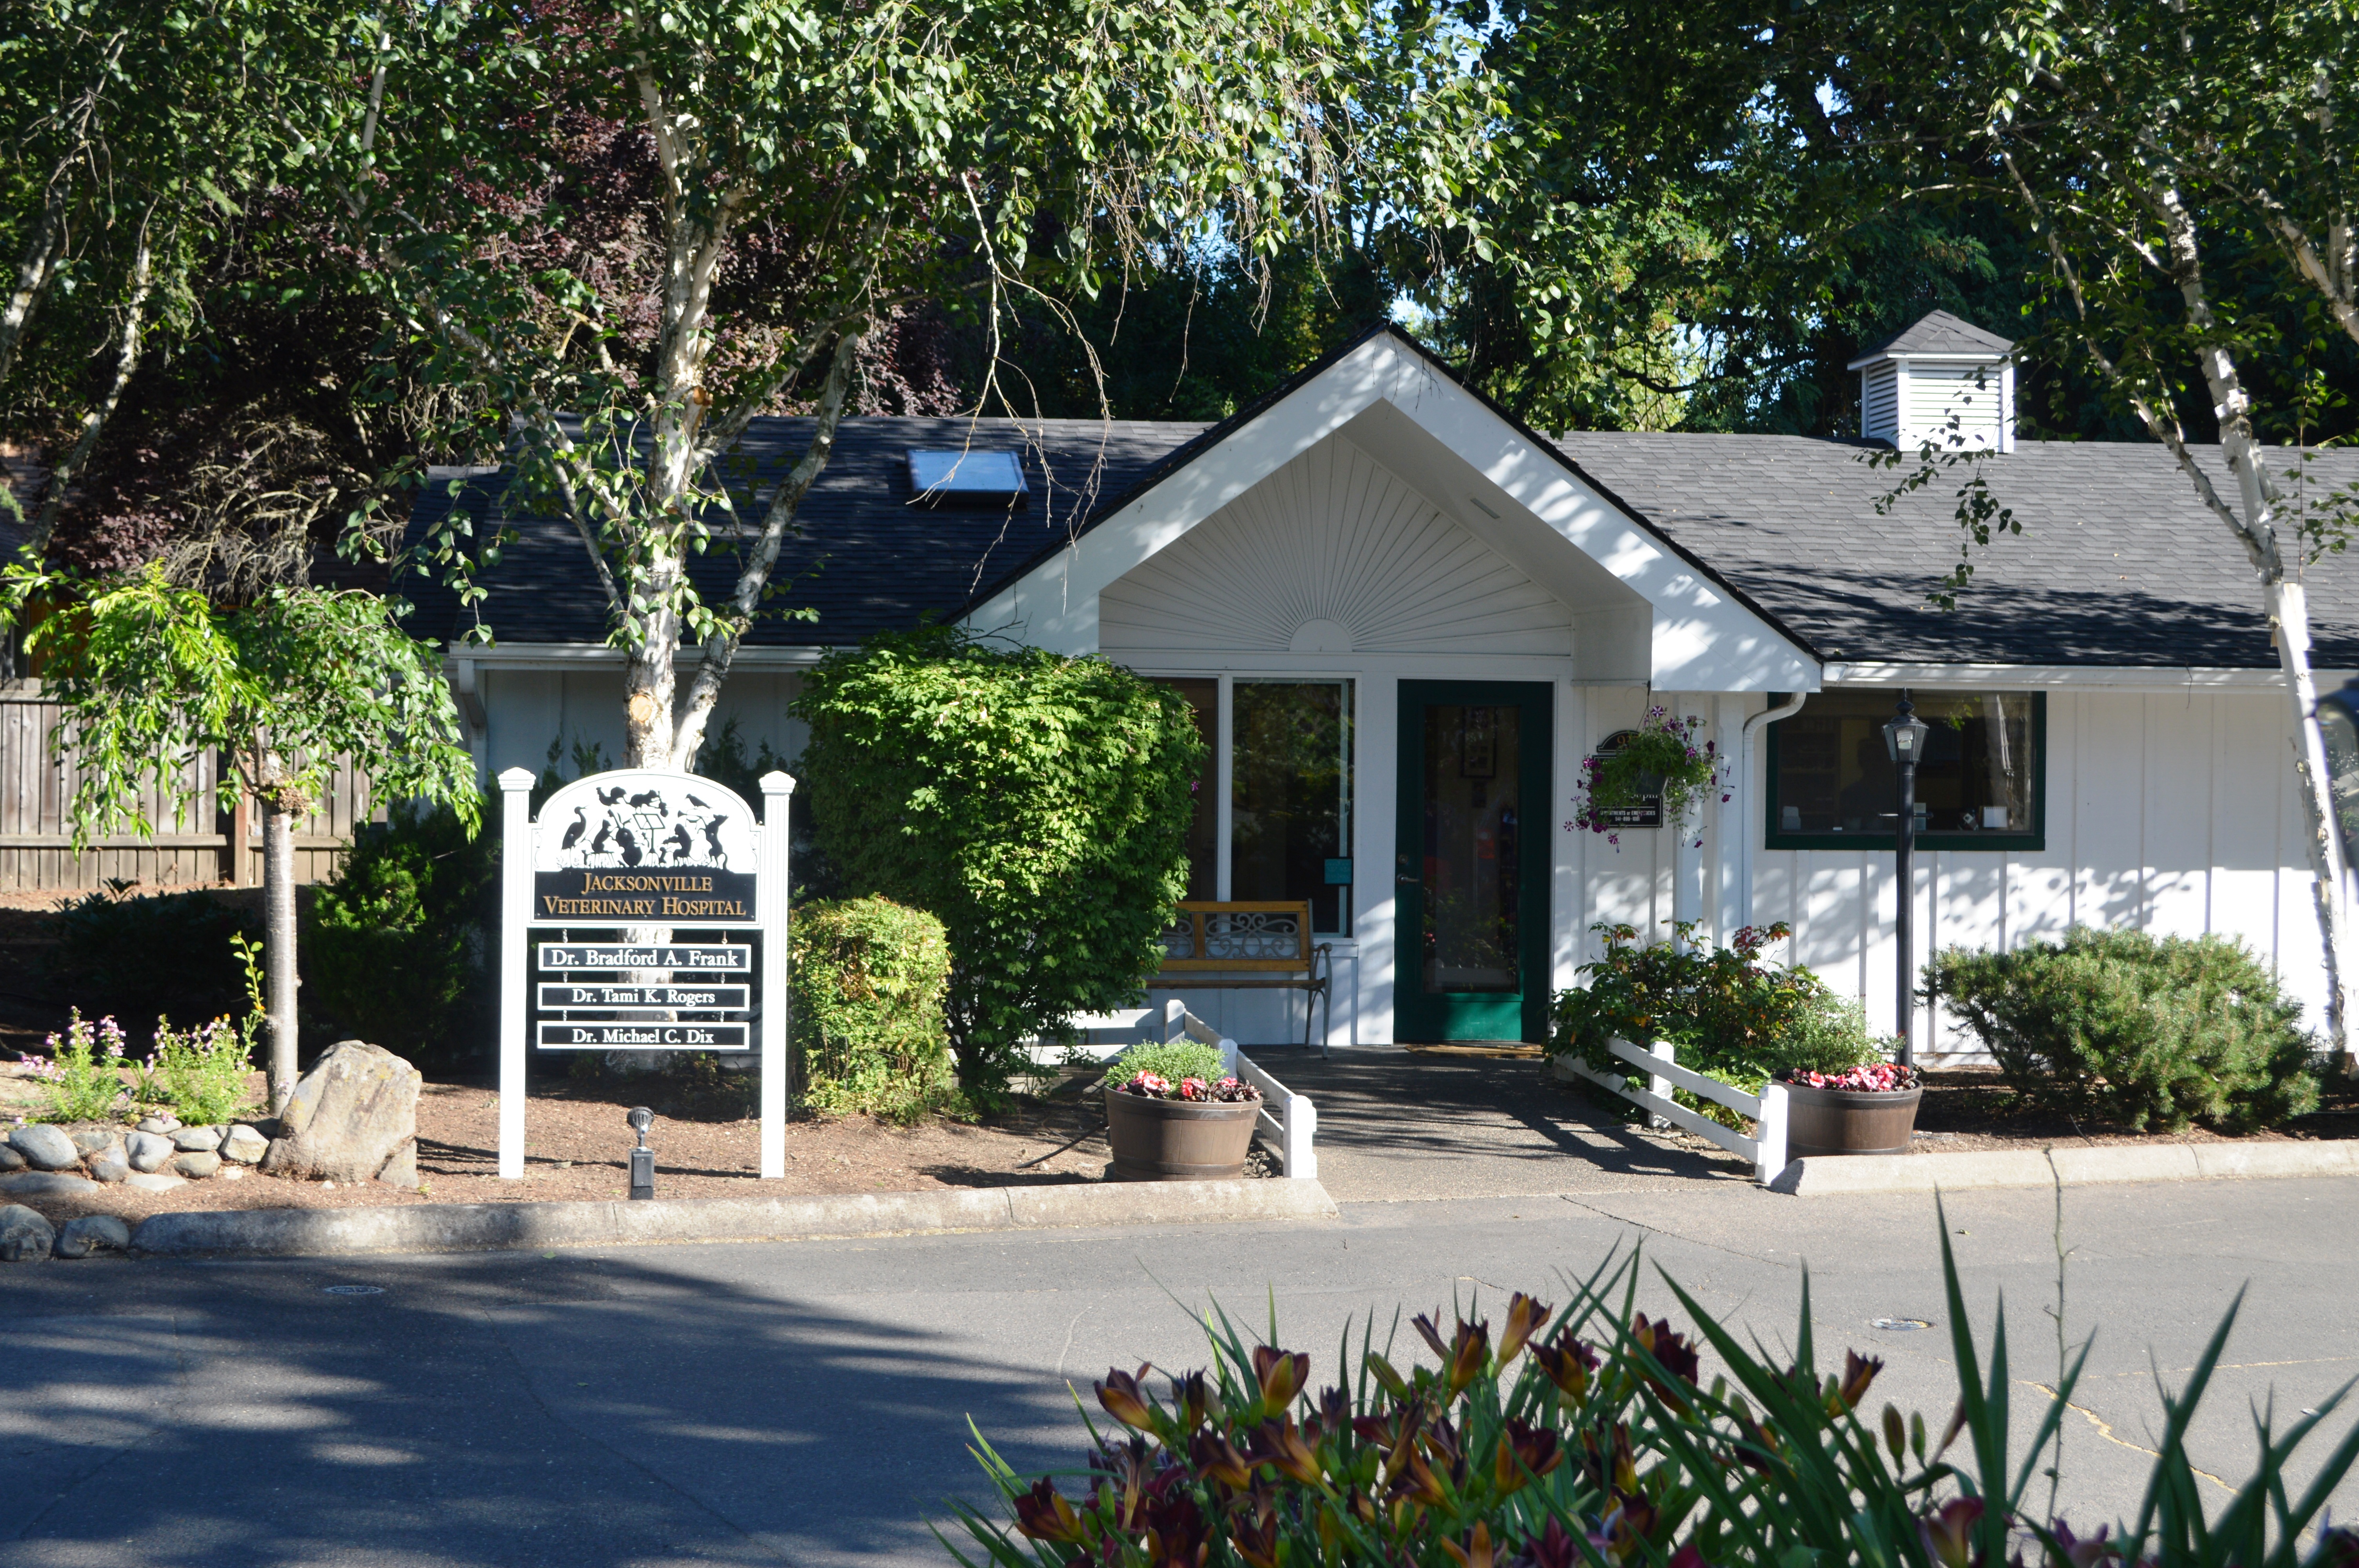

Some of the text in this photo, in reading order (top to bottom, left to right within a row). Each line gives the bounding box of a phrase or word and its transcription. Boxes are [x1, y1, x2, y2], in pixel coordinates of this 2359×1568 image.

[582, 873, 712, 894] JACKSONVILLE
[544, 897, 746, 915] VETERINARY HOSPITAL
[551, 949, 738, 966] Dr. Bradford A. Frank
[572, 989, 715, 1006] Dr. Tami K. Rogers
[572, 1029, 714, 1043] Dr. Michael C. Dix
